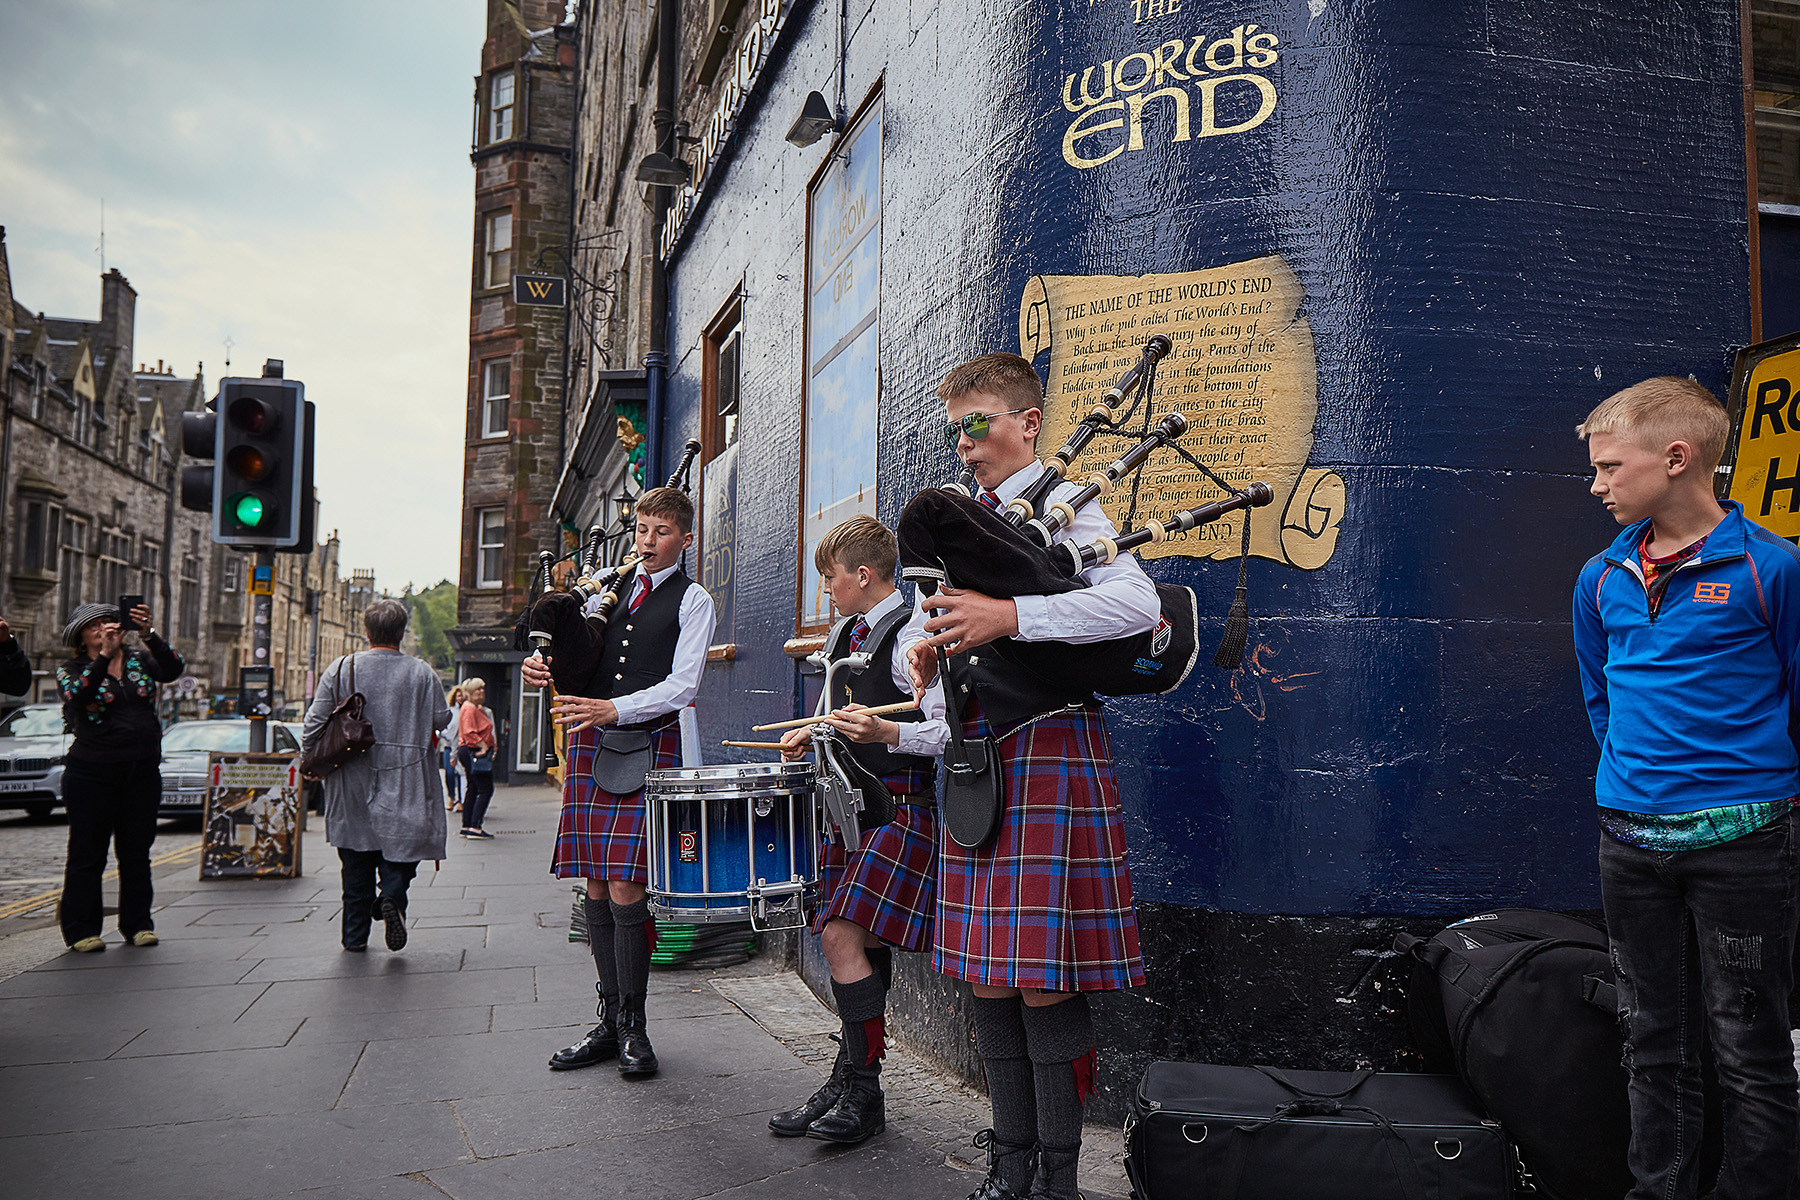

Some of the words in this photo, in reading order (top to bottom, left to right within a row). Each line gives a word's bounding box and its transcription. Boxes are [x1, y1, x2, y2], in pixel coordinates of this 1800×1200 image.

[1130, 0, 1183, 24] THE
[526, 281, 552, 299] W
[1066, 304, 1086, 322] THE
[1090, 296, 1123, 316] NAME
[1128, 292, 1144, 308] OF
[1148, 288, 1172, 305] THE
[1178, 278, 1236, 300] WORLD'S
[1242, 277, 1272, 294] END
[1066, 324, 1086, 343] Why
[1090, 324, 1096, 335] is
[1100, 318, 1114, 333] the
[1118, 314, 1137, 337] pub
[1141, 309, 1170, 326] called
[1174, 307, 1193, 322] The
[1196, 302, 1238, 320] World's
[1074, 340, 1094, 356] Back
[1098, 341, 1107, 352] in
[1112, 335, 1126, 349] the
[1200, 323, 1216, 337] the
[1221, 324, 1241, 340] city
[1247, 319, 1260, 339] of
[1063, 356, 1109, 377] Edinburgh
[1113, 356, 1131, 367] was
[1209, 344, 1237, 356] Parts
[1242, 339, 1255, 359] of
[1258, 338, 1275, 353] the
[1062, 377, 1094, 394] Flodden
[1170, 368, 1180, 378] in
[1186, 361, 1202, 377] the
[1201, 359, 1272, 381] foundations
[1071, 396, 1080, 412] of
[1083, 392, 1096, 406] the
[1167, 385, 1178, 396] at
[1183, 379, 1199, 393] the
[1204, 378, 1242, 392] bottom
[1248, 375, 1260, 395] of
[1151, 399, 1168, 414] The
[1205, 399, 1216, 409] to
[1221, 394, 1238, 408] the
[1242, 396, 1263, 412] city
[1216, 410, 1232, 427] the
[1238, 412, 1266, 426] brass
[1098, 443, 1107, 454] in
[1112, 440, 1126, 452] the
[1209, 431, 1235, 445] their
[1240, 433, 1268, 444] exact
[1159, 456, 1169, 465] as
[1234, 447, 1246, 467] of
[1156, 472, 1206, 484] concerned
[1119, 494, 1133, 503] wa
[1142, 492, 1153, 501] no
[1159, 487, 1191, 505] longer
[1196, 484, 1222, 498] their
[1117, 507, 1144, 520] hece
[1149, 505, 1164, 519] the
[1199, 524, 1232, 540] END
[1694, 582, 1730, 600] BG
